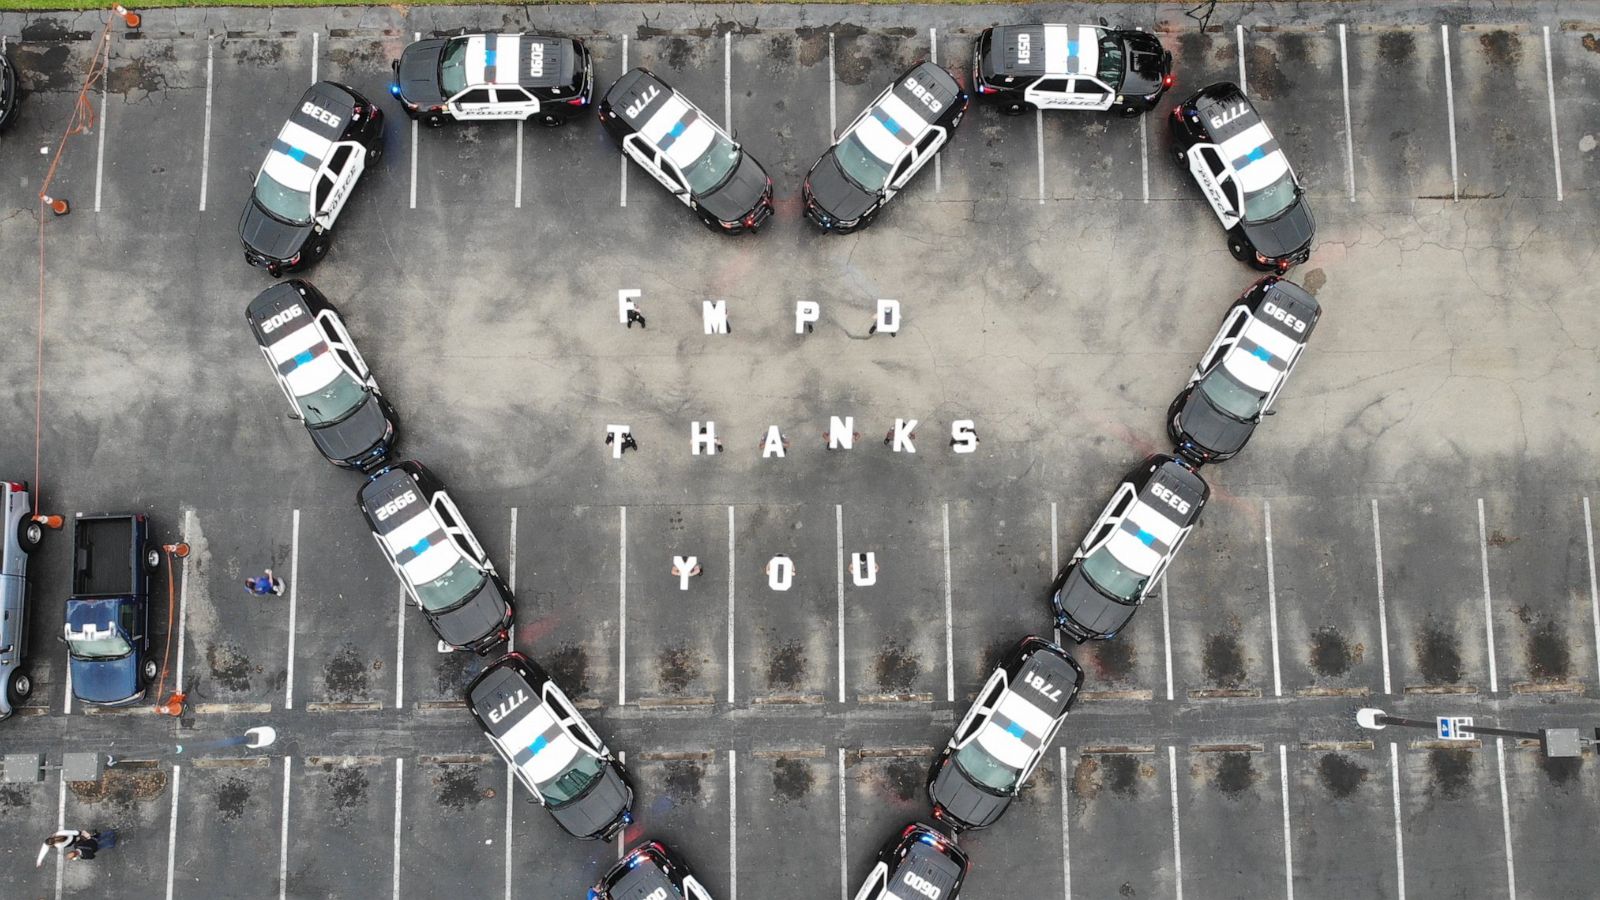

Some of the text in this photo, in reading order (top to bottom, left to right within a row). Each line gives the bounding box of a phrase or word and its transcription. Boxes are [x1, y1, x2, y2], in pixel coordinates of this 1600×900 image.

[529, 42, 545, 78] 0602
[1017, 33, 1031, 65] 0591
[626, 84, 661, 120] 7778
[903, 76, 943, 114] 6386
[301, 101, 342, 129] 9338
[1210, 101, 1250, 130] 7779
[260, 303, 303, 334] 9002
[1262, 301, 1307, 334] 6390
[374, 489, 418, 522] 9992
[1150, 482, 1191, 515] 9339
[1024, 671, 1063, 703] 7781
[487, 688, 529, 724] 7773
[902, 871, 942, 900] 0600
